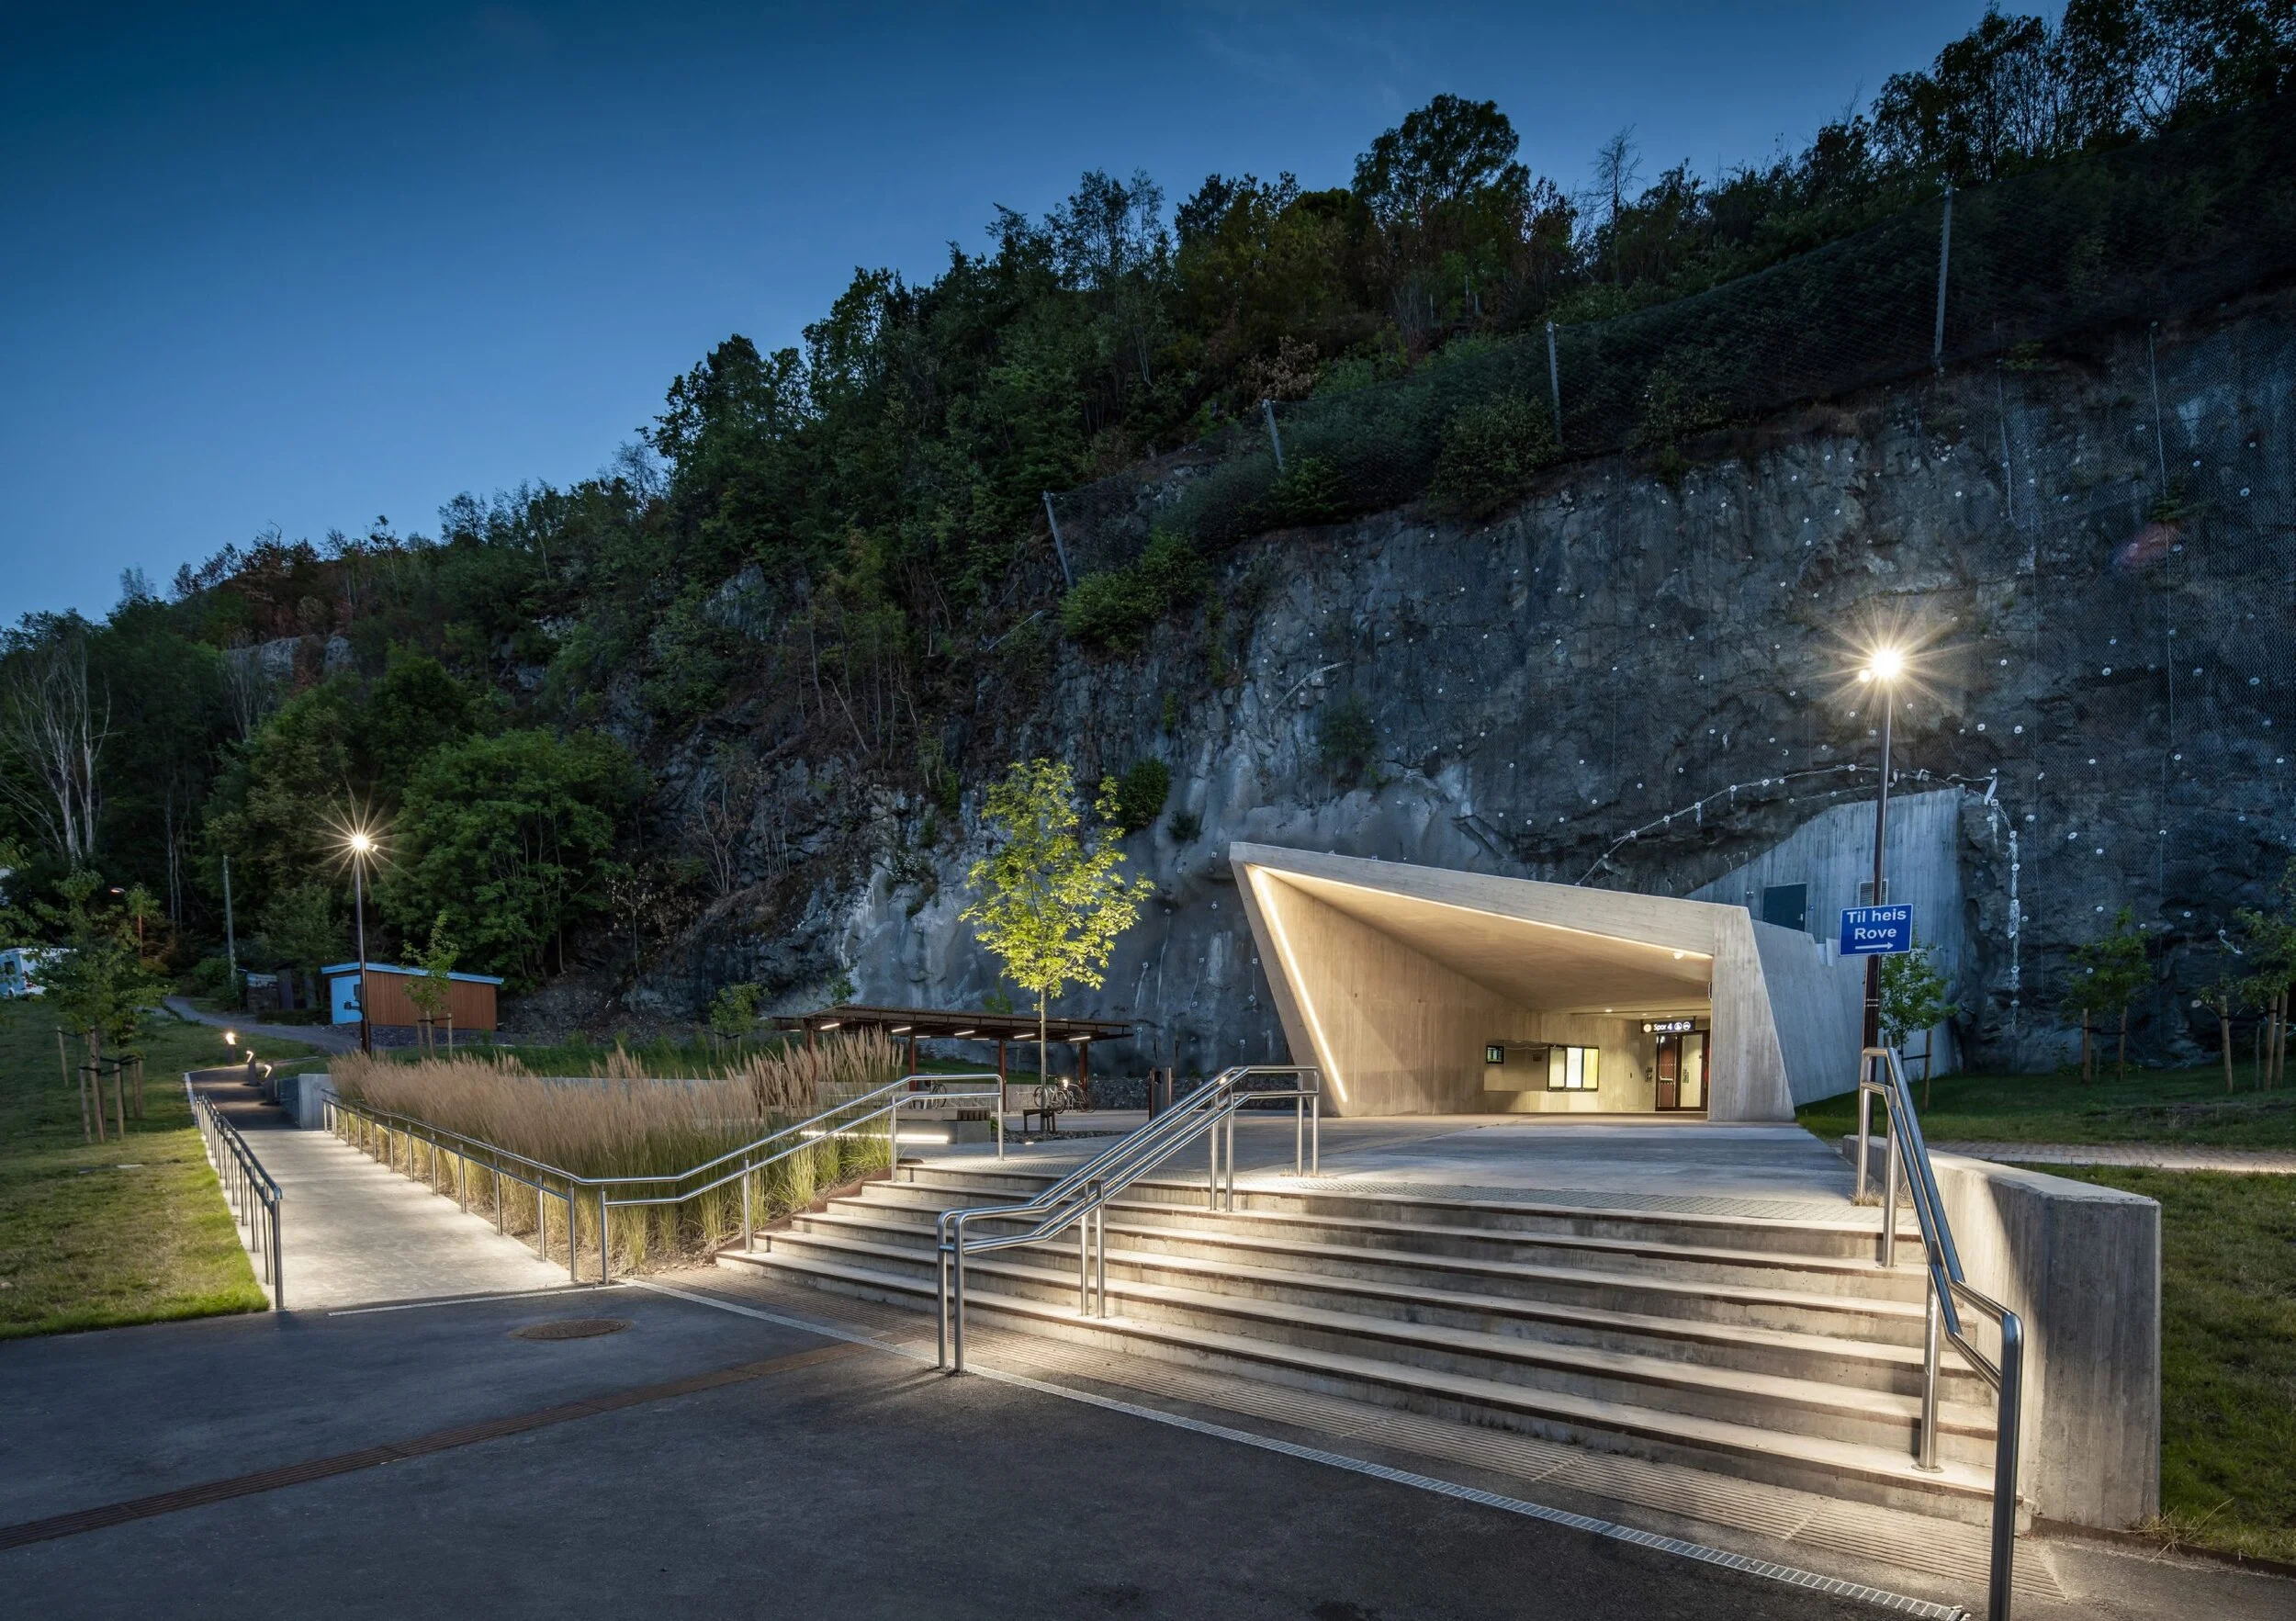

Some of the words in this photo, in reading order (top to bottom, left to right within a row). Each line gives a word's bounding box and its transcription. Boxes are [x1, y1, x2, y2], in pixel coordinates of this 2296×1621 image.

[1847, 910, 1865, 923] Til
[1872, 908, 1907, 922] heis
[1854, 928, 1896, 940] Rove
[1653, 1023, 1667, 1031] Spor
[1667, 1022, 1672, 1030] 4
